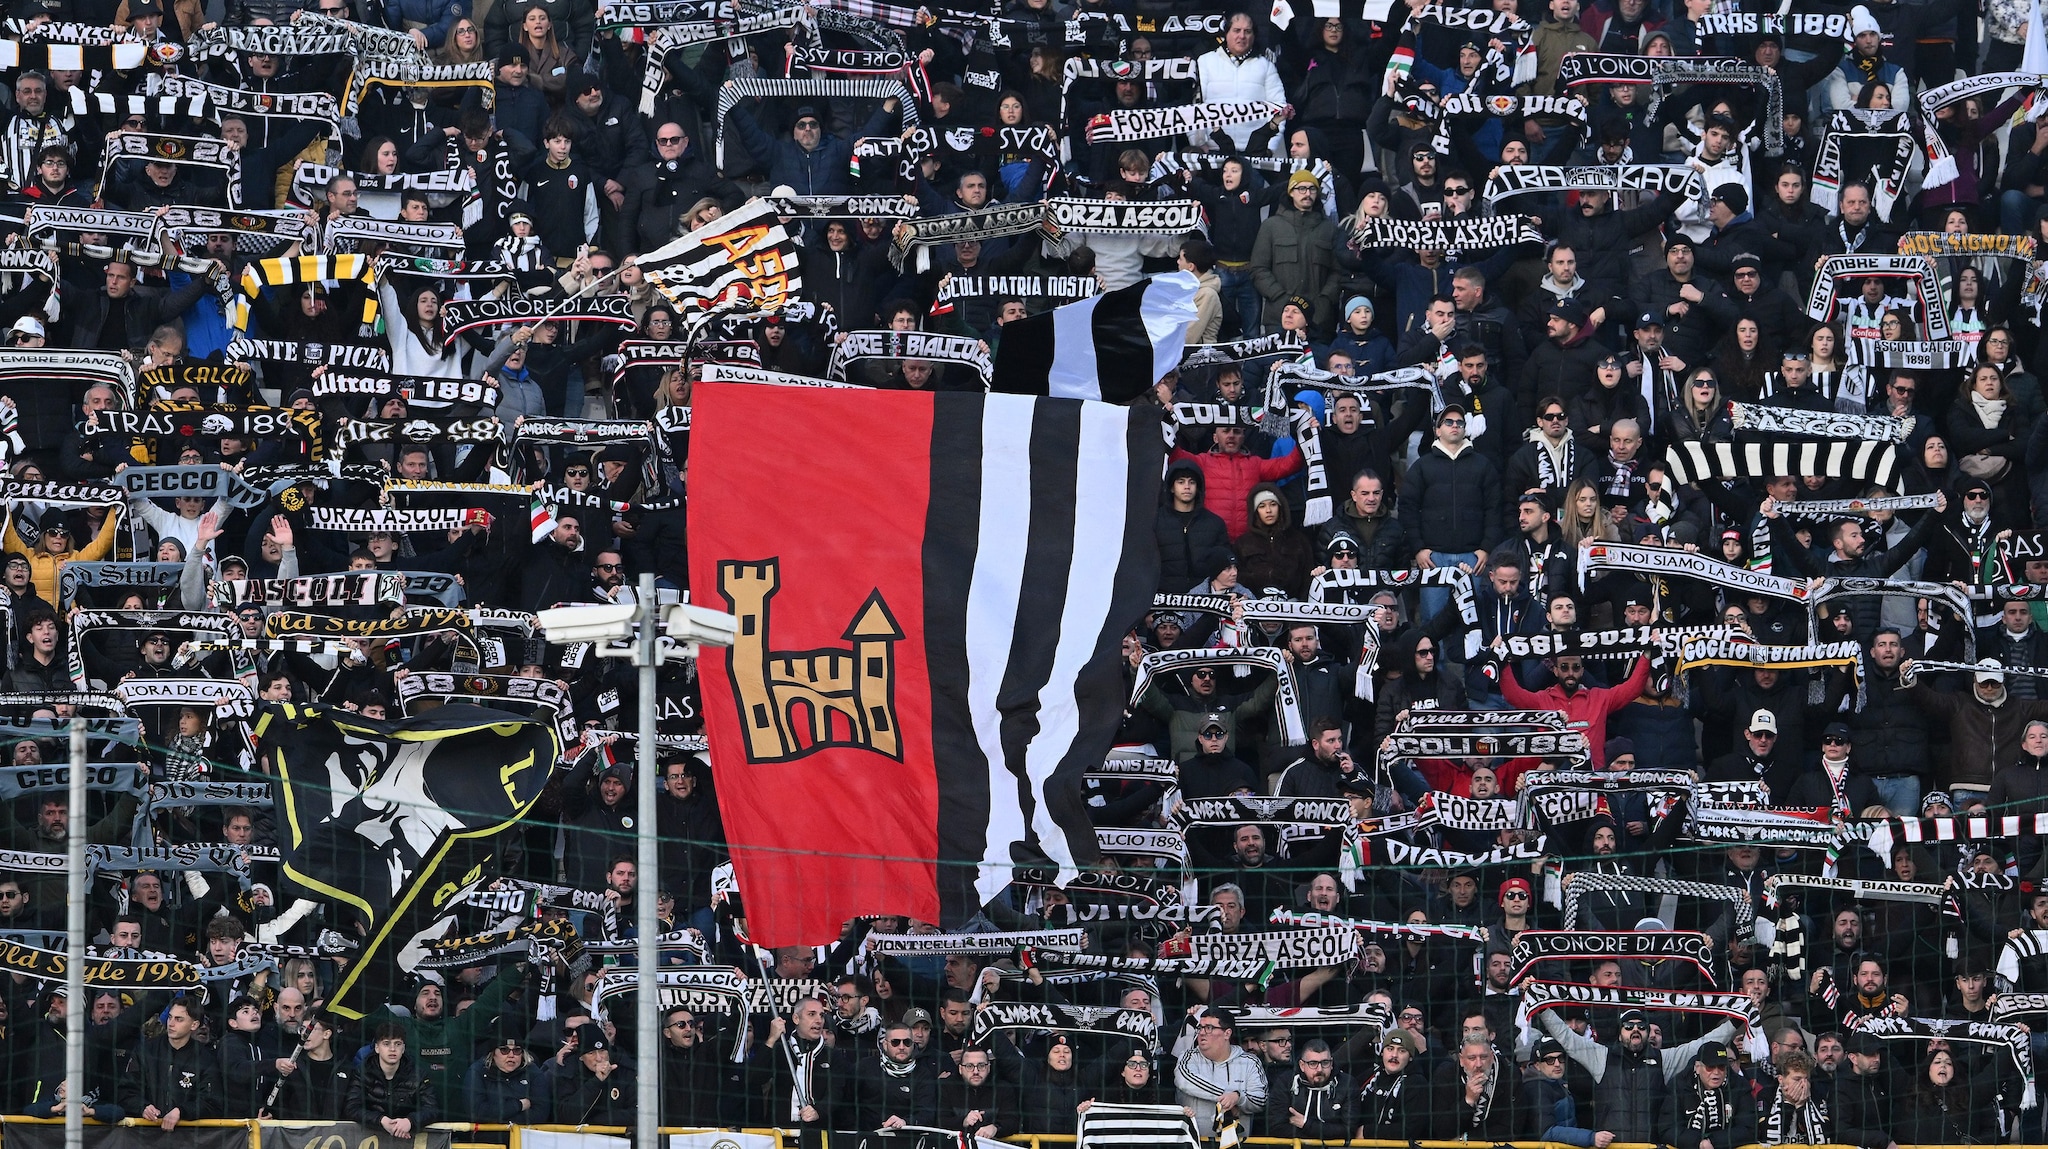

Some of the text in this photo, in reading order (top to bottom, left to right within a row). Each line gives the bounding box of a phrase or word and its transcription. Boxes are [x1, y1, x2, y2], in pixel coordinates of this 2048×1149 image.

[231, 33, 341, 55] RAGAZZI
[1115, 101, 1270, 134] FORZA ASCOLI
[45, 212, 97, 227] SIAMO
[101, 215, 121, 228] LA
[917, 215, 978, 238] FORZA
[1122, 206, 1197, 227] ASCOLI
[387, 222, 445, 238] CALCIO
[1947, 234, 2009, 251] SIGNO
[989, 277, 1042, 297] PATRIA
[471, 297, 555, 319] L'ONORE
[563, 298, 581, 314] DI
[1874, 340, 1962, 352] ASCOLI CALCIO
[1907, 353, 1931, 365] 1898
[1173, 402, 1236, 425] COLI
[1759, 415, 1892, 440] ASCOLI
[127, 473, 217, 493] CECCO
[382, 509, 461, 525] ASCOLI
[98, 564, 170, 587] Style
[1620, 551, 1780, 590] NOI SIAMO LA STORIA
[242, 578, 367, 603] ASCOLI
[1299, 604, 1362, 619] CALCIO
[326, 616, 408, 636] Style
[1143, 647, 1294, 707] ASCOLI CALCIO 1898
[126, 685, 198, 697] L'ORA DE
[53, 718, 120, 735] VVE
[1475, 711, 1526, 726] Sud
[152, 783, 195, 803] Old
[1438, 800, 1508, 821] FORZA
[1760, 827, 1833, 844] BIANCONERO
[0, 854, 64, 867] CALCIO
[977, 932, 1078, 948] BIANCONERO
[1536, 936, 1629, 954] L'ONORE
[1637, 937, 1655, 953] DI
[1197, 940, 1268, 962] FORZA
[46, 955, 127, 981] Syle
[602, 973, 741, 986] ASCLI CALCIO
